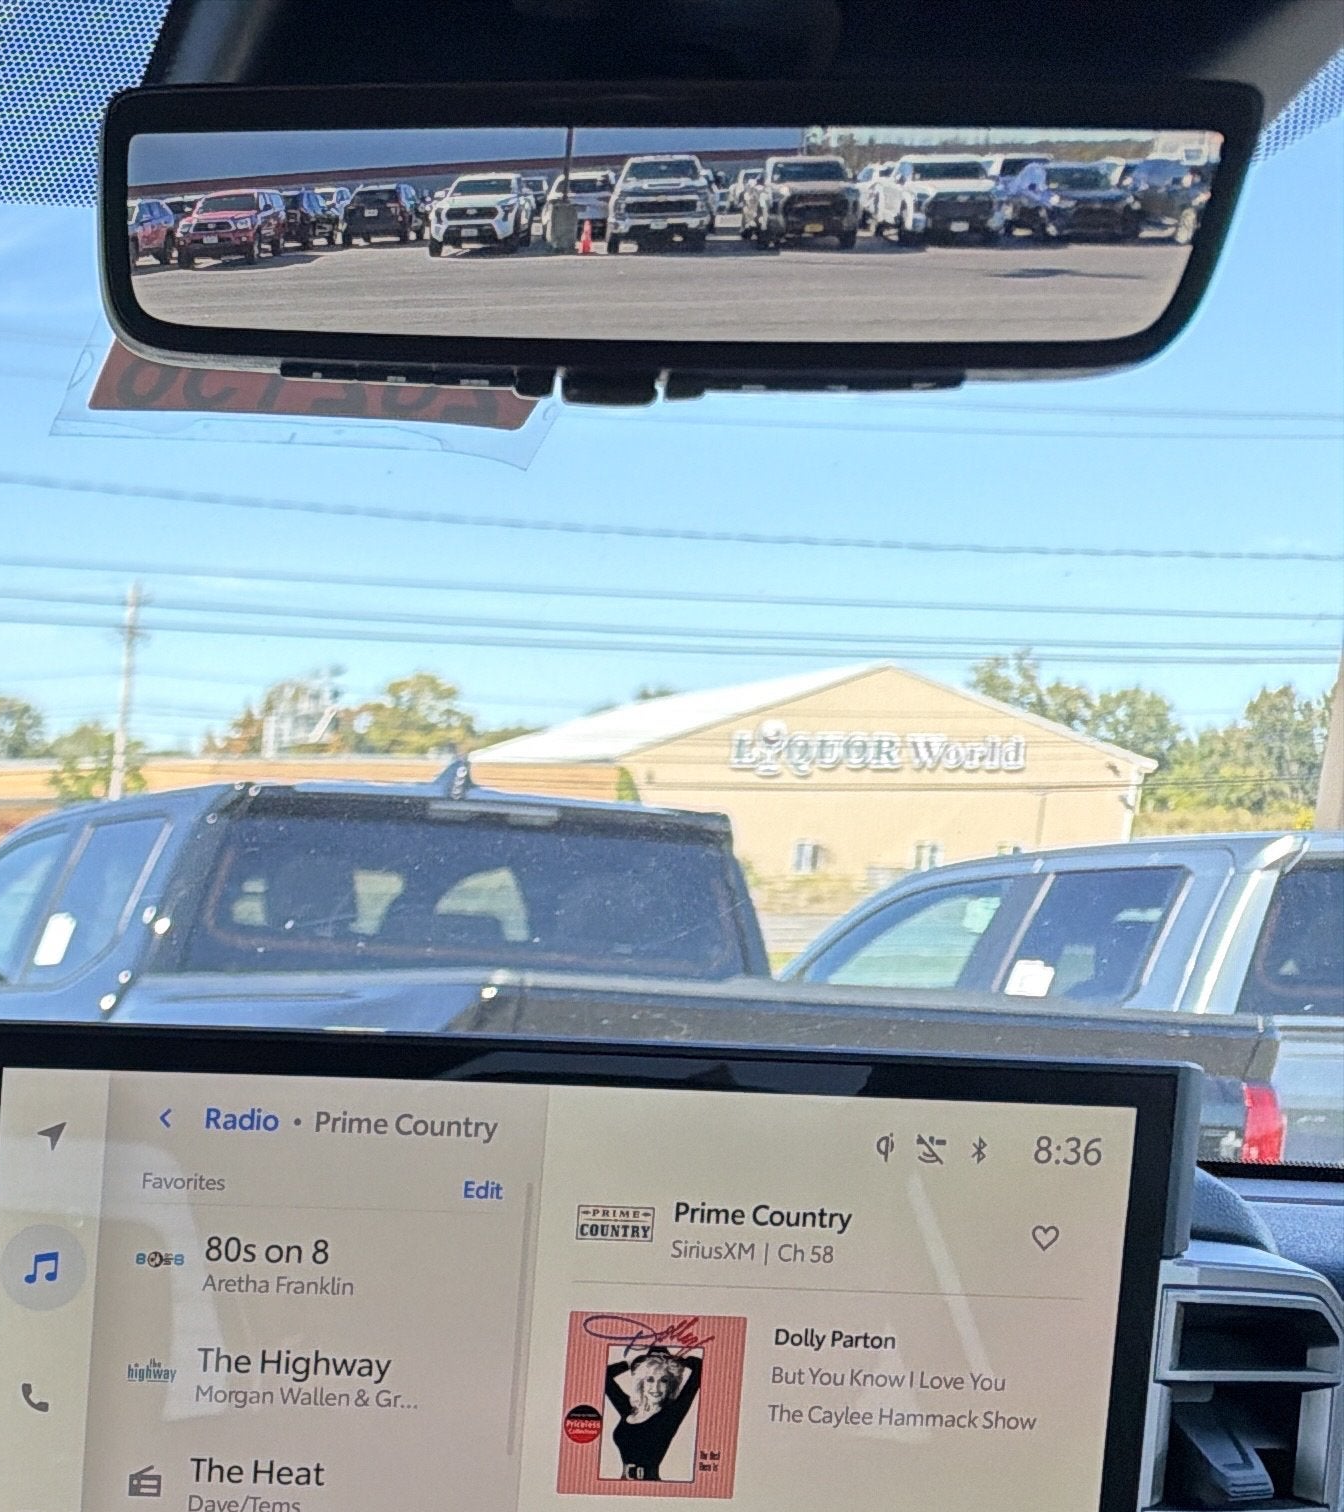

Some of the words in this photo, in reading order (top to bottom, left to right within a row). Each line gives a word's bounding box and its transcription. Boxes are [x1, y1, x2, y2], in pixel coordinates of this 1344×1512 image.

[912, 734, 1026, 771] World
[204, 1106, 280, 1132] Radio
[314, 1111, 389, 1138] Prime
[393, 1113, 499, 1144] Country
[1032, 1135, 1103, 1167] 8:36
[141, 1171, 226, 1192] Favorites
[462, 1180, 505, 1201] Edit
[592, 1208, 641, 1219] PRIME
[674, 1203, 746, 1226] Prime
[751, 1204, 853, 1234] Country
[579, 1223, 651, 1238] COUNTRY
[205, 1236, 258, 1265] 80s
[265, 1244, 304, 1265] on
[310, 1239, 331, 1266] 8
[670, 1239, 757, 1263] SiriusXM
[777, 1242, 807, 1264] Ch
[810, 1243, 835, 1265] 58
[201, 1275, 273, 1296] Aretha
[277, 1276, 355, 1298] Franklin
[774, 1328, 827, 1352] Dolly
[831, 1331, 897, 1350] Parton
[127, 1362, 177, 1383] highway
[197, 1347, 253, 1375] The
[259, 1350, 393, 1385] Highway
[771, 1367, 805, 1387] But
[808, 1368, 846, 1388] You
[849, 1369, 907, 1390] Know
[909, 1371, 915, 1390] I
[918, 1372, 966, 1391] Love
[968, 1373, 1007, 1392] You
[195, 1385, 272, 1411] Morgan
[278, 1387, 351, 1408] Wallen
[354, 1390, 371, 1409] &
[768, 1405, 804, 1426] The
[807, 1406, 875, 1432] Caylee
[878, 1408, 977, 1431] Hammack
[981, 1411, 1038, 1432] Show
[190, 1457, 245, 1486] The
[251, 1459, 327, 1487] Heat
